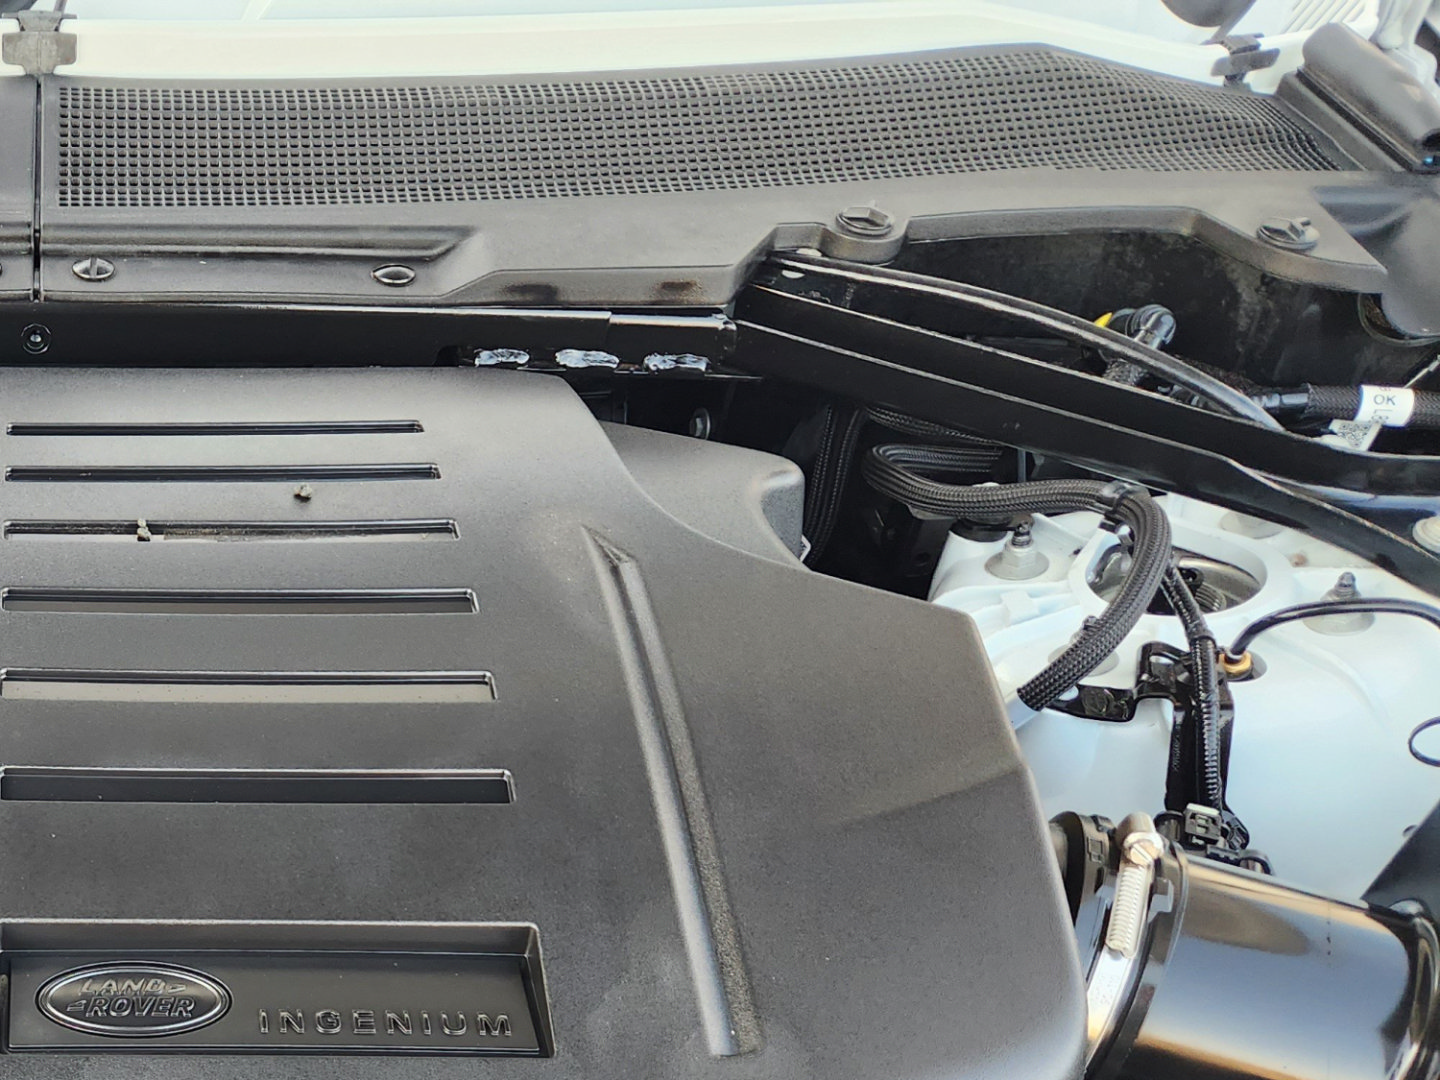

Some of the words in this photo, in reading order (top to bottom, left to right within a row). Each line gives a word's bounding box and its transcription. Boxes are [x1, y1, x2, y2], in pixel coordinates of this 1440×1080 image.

[1373, 394, 1396, 406] OK
[80, 978, 166, 996] LAND
[85, 996, 195, 1017] ROVER
[259, 1009, 512, 1036] INGENIUM
